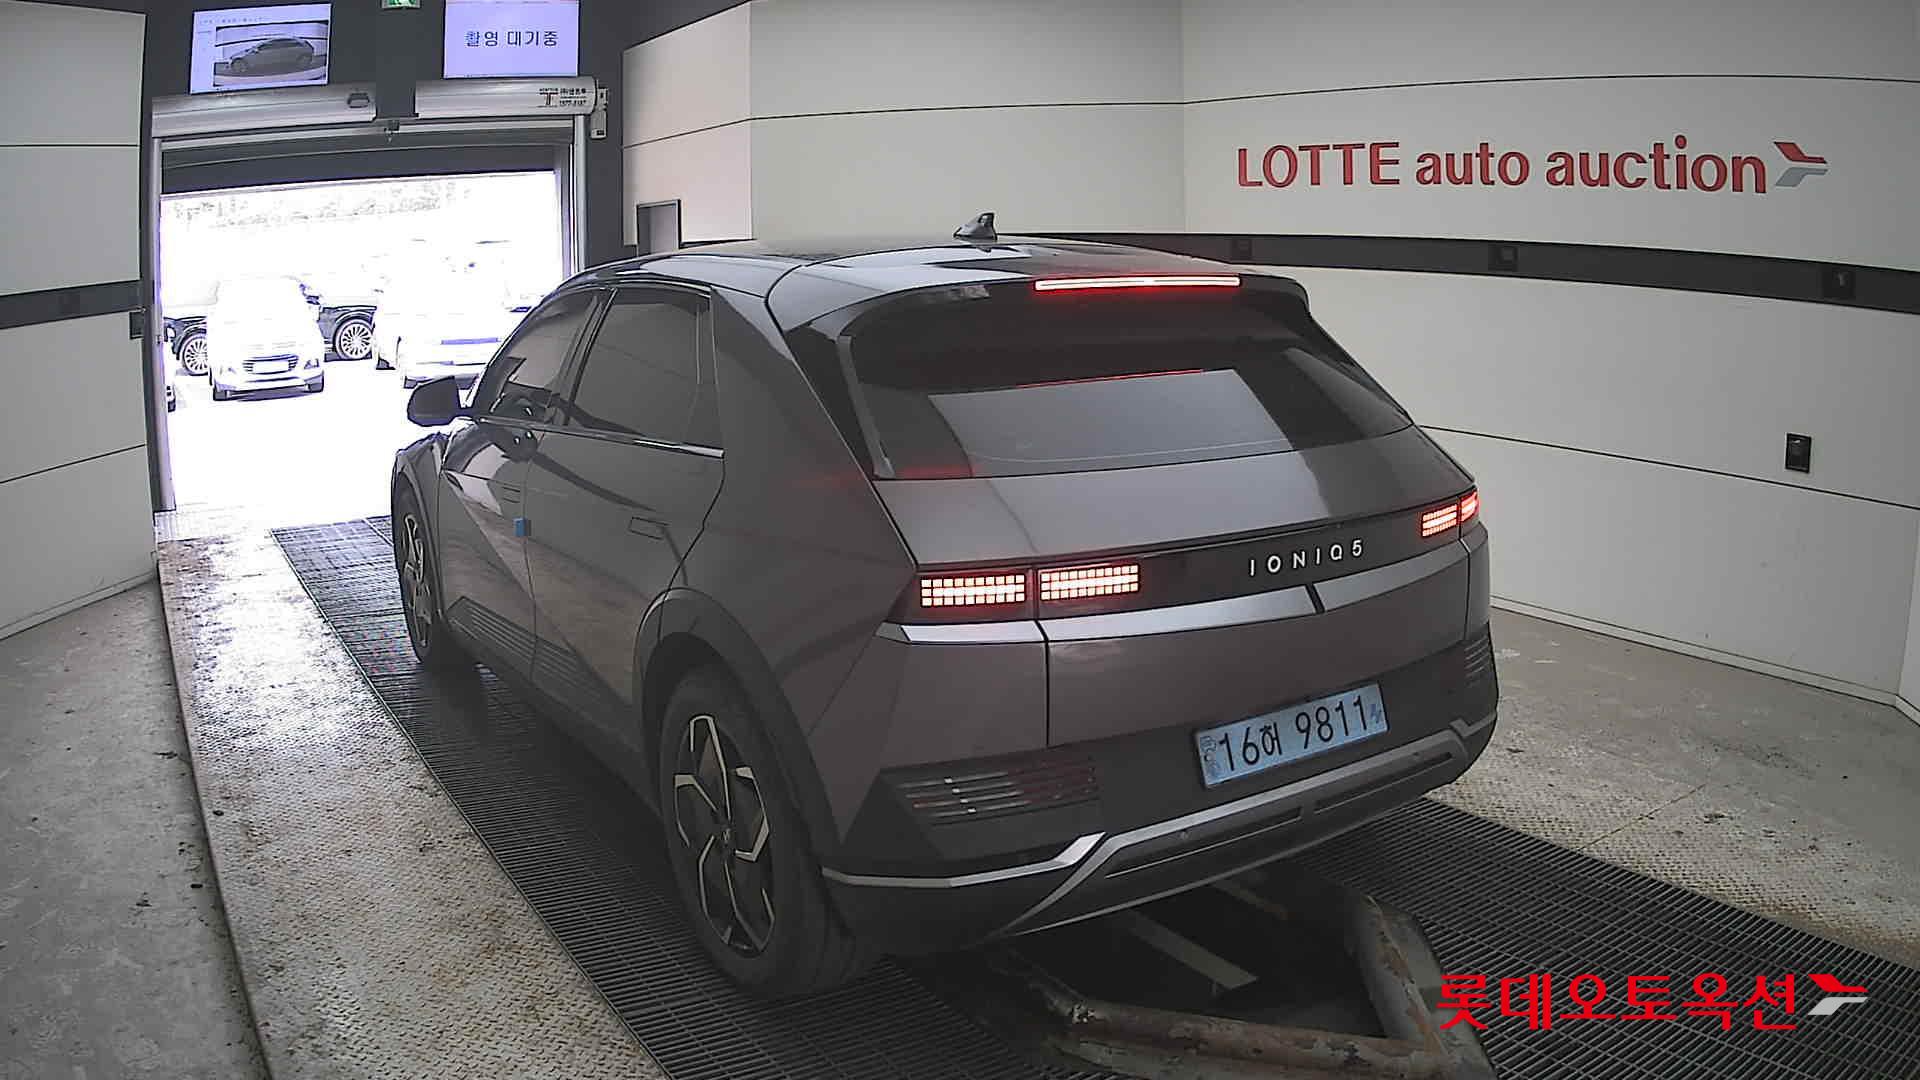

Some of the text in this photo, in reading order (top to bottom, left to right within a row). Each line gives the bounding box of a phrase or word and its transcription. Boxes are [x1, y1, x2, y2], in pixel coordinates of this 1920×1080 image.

[507, 31, 559, 47] 대기중
[1237, 134, 1767, 194] LOTTE auto auction
[1219, 695, 1368, 772] 16허 9811
